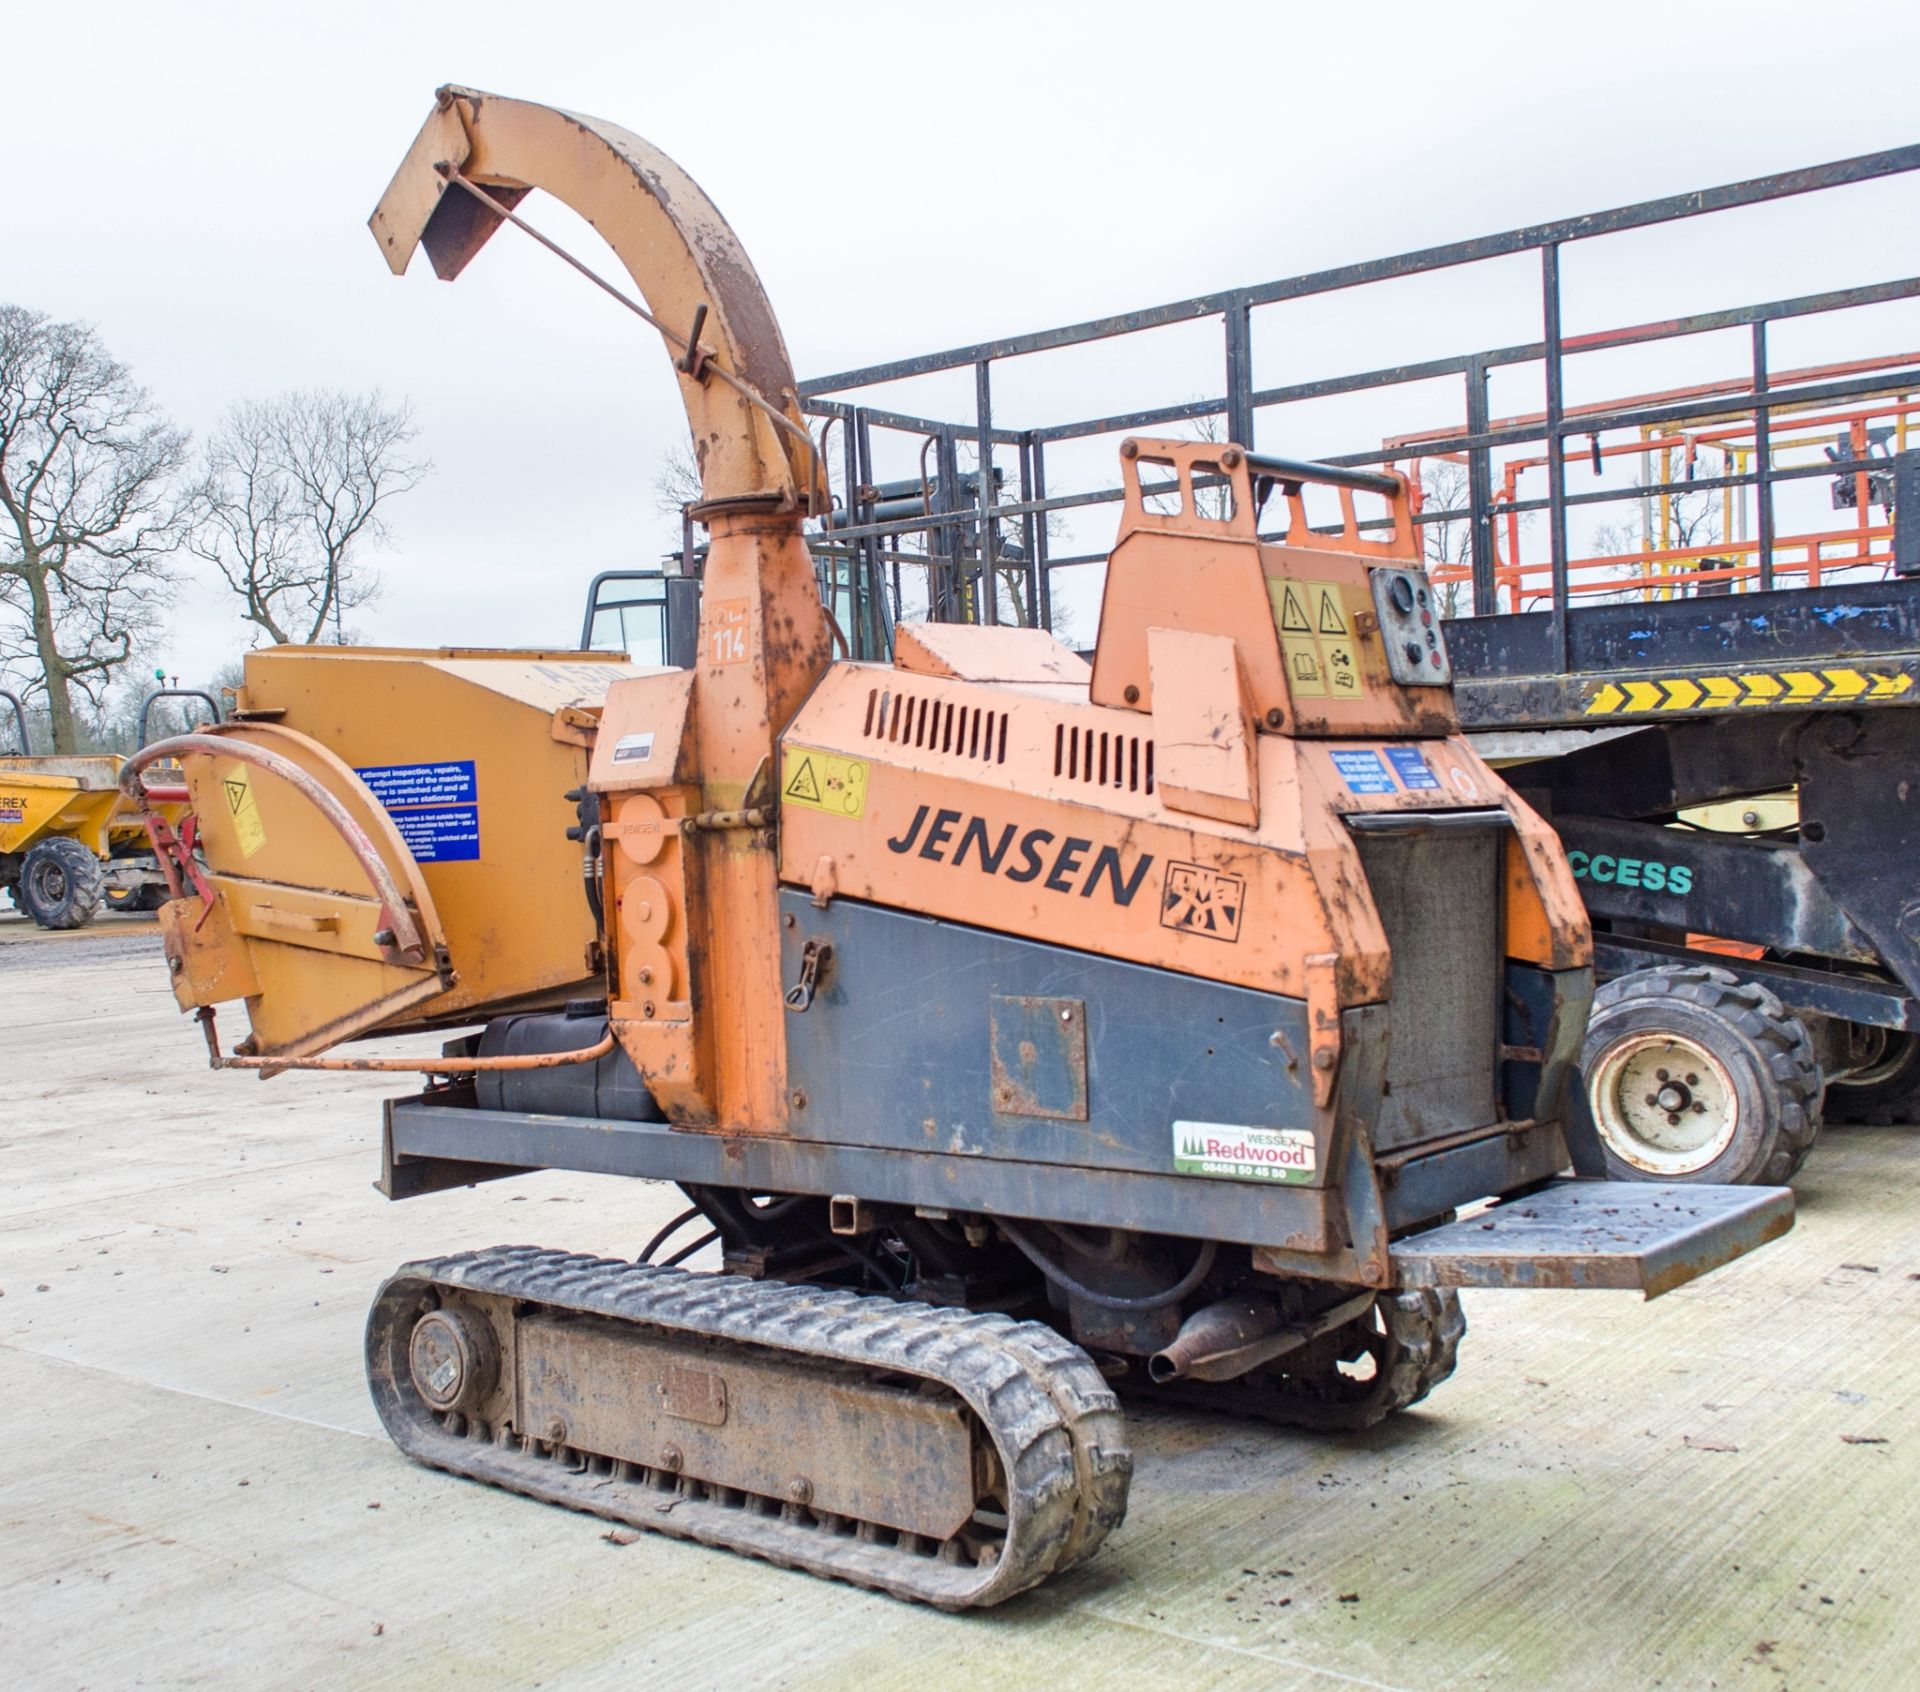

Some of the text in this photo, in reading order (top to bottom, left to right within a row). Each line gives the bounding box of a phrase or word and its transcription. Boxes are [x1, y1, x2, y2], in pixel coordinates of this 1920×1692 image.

[713, 627, 744, 660] 114
[362, 770, 391, 778] attempt
[373, 778, 414, 787] adjustment
[438, 774, 470, 782] machine
[397, 785, 431, 795] switched
[431, 784, 443, 792] off
[443, 784, 458, 792] and
[459, 783, 469, 791] all
[386, 797, 405, 805] parts
[420, 794, 458, 803] stationary
[887, 805, 1154, 907] JENSEN
[1247, 1133, 1297, 1147] WESSEX
[1207, 1138, 1306, 1165] Redwood
